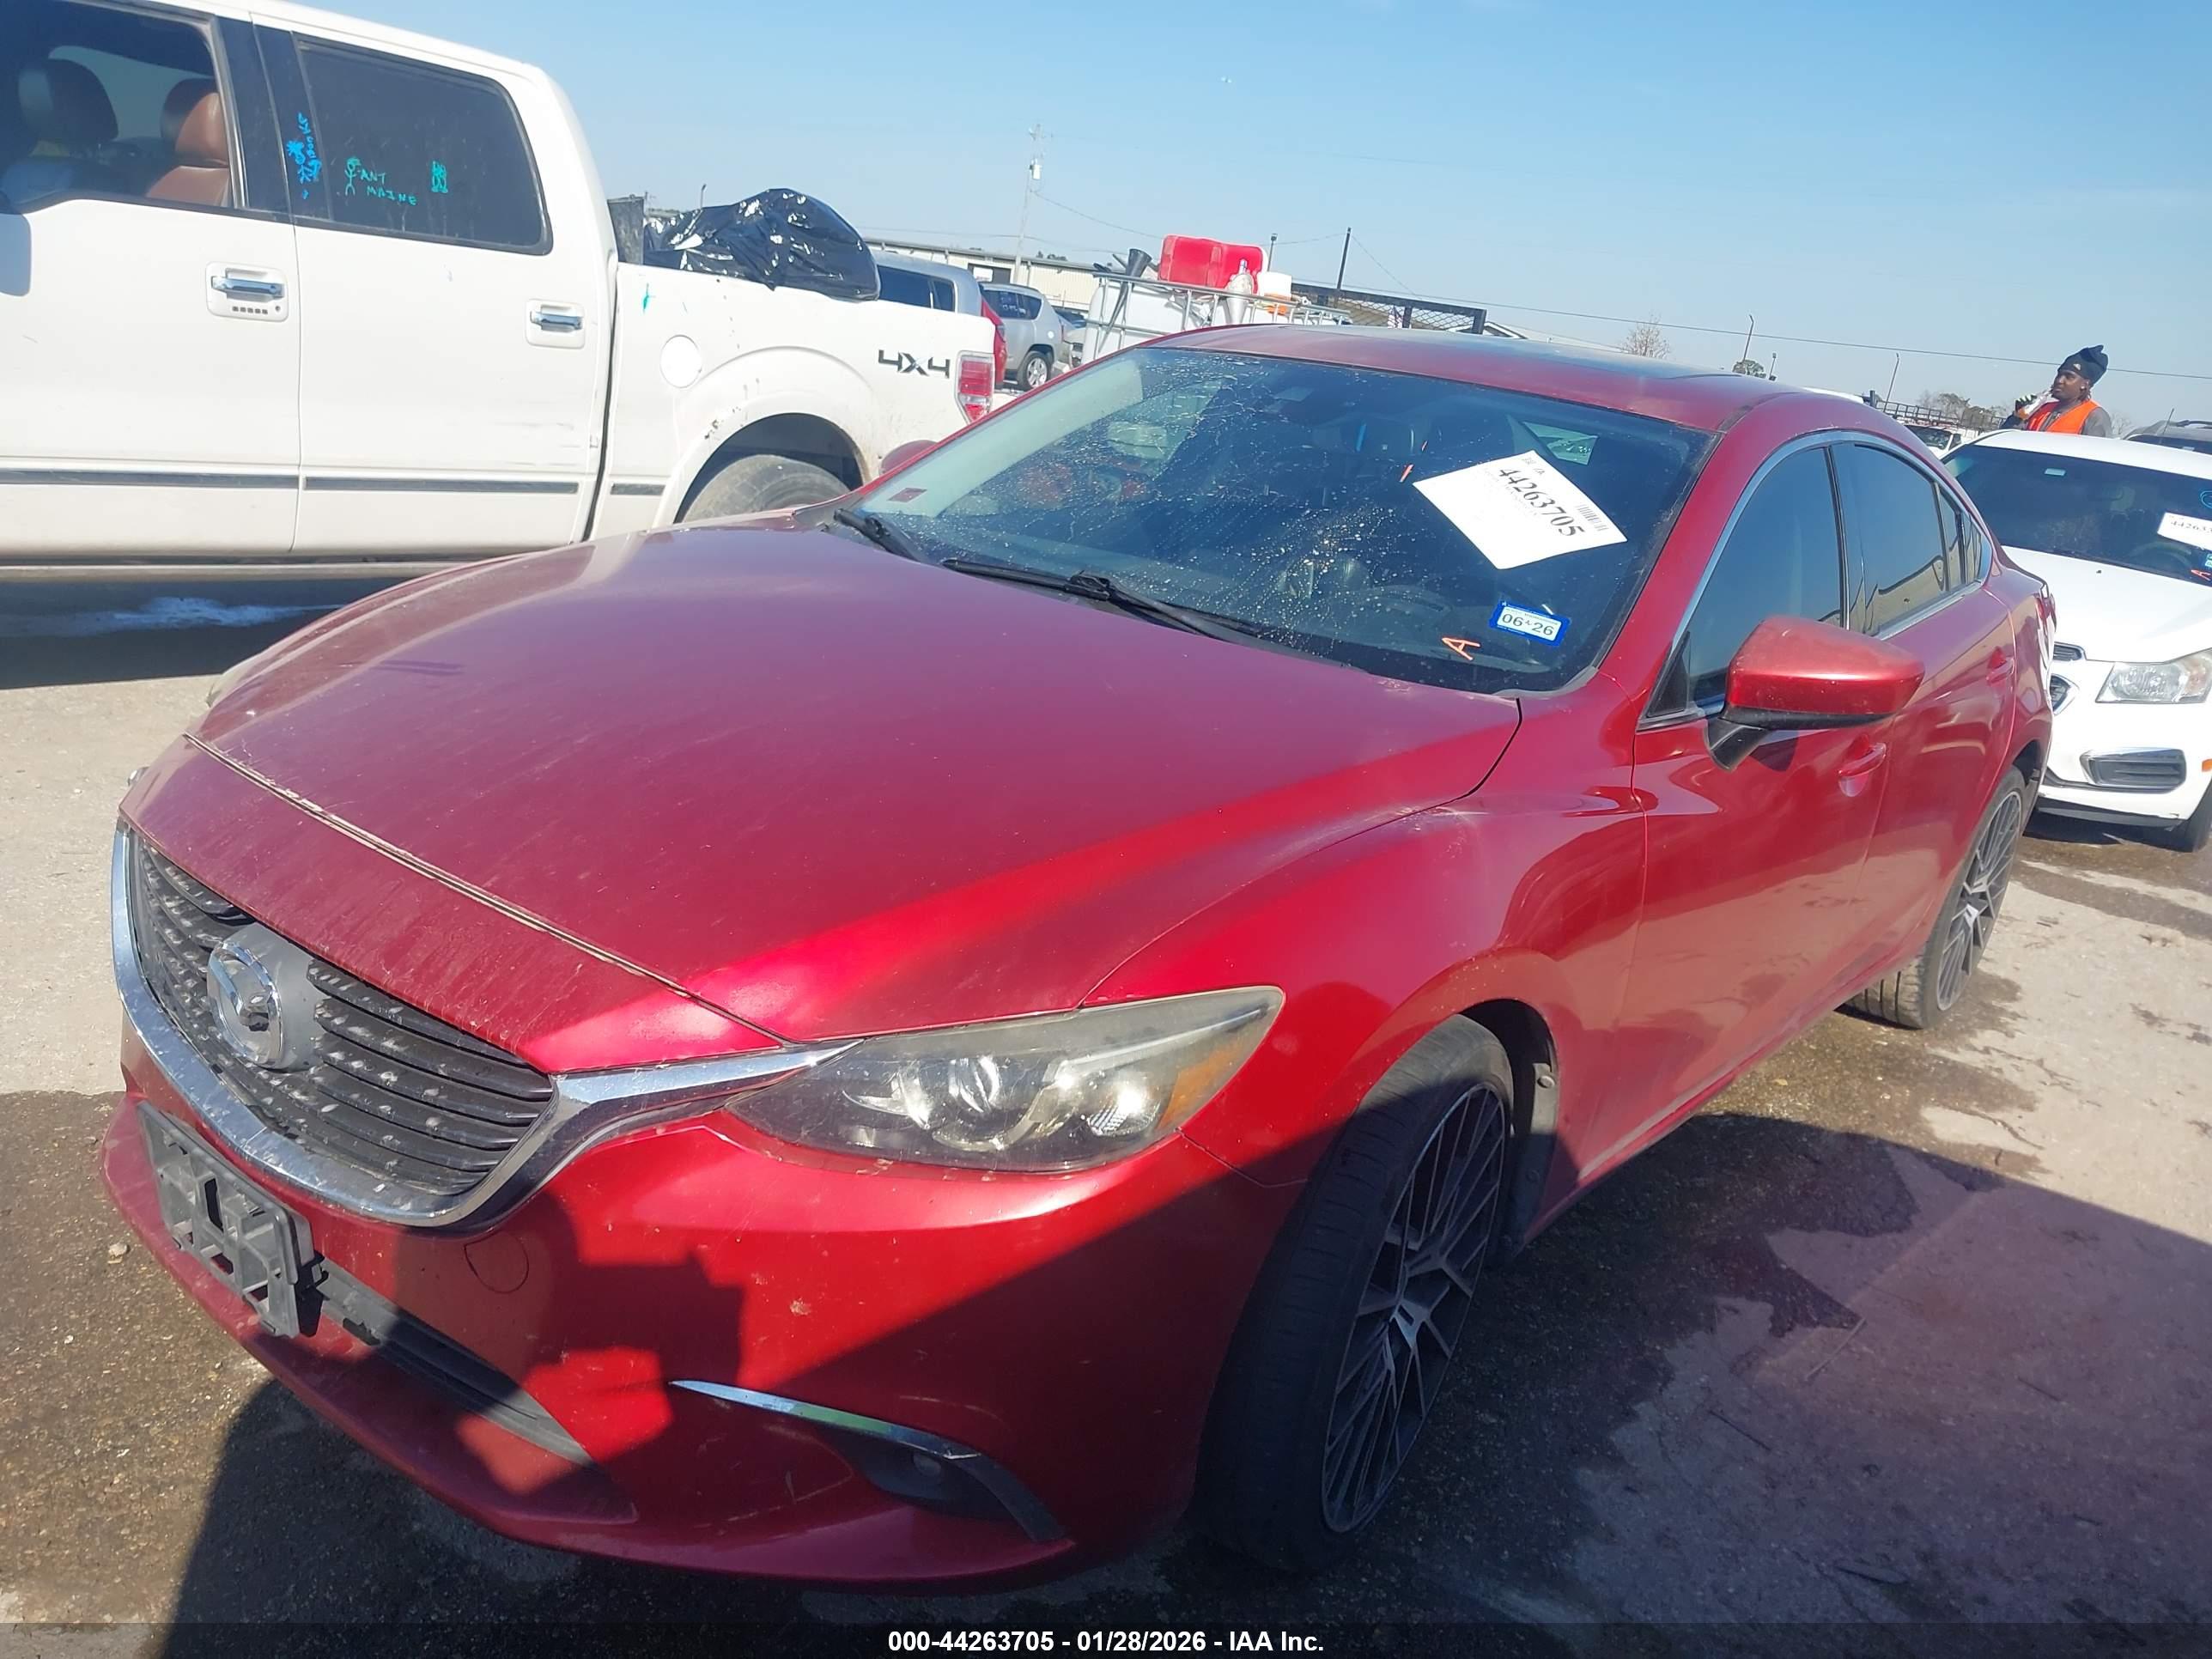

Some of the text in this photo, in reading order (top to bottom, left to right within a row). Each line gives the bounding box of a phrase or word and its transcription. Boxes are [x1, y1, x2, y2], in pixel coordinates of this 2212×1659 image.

[1498, 468, 1586, 537] 44263705
[1501, 613, 1525, 627] 06
[1531, 622, 1555, 636] 26
[1442, 636, 1480, 661] A
